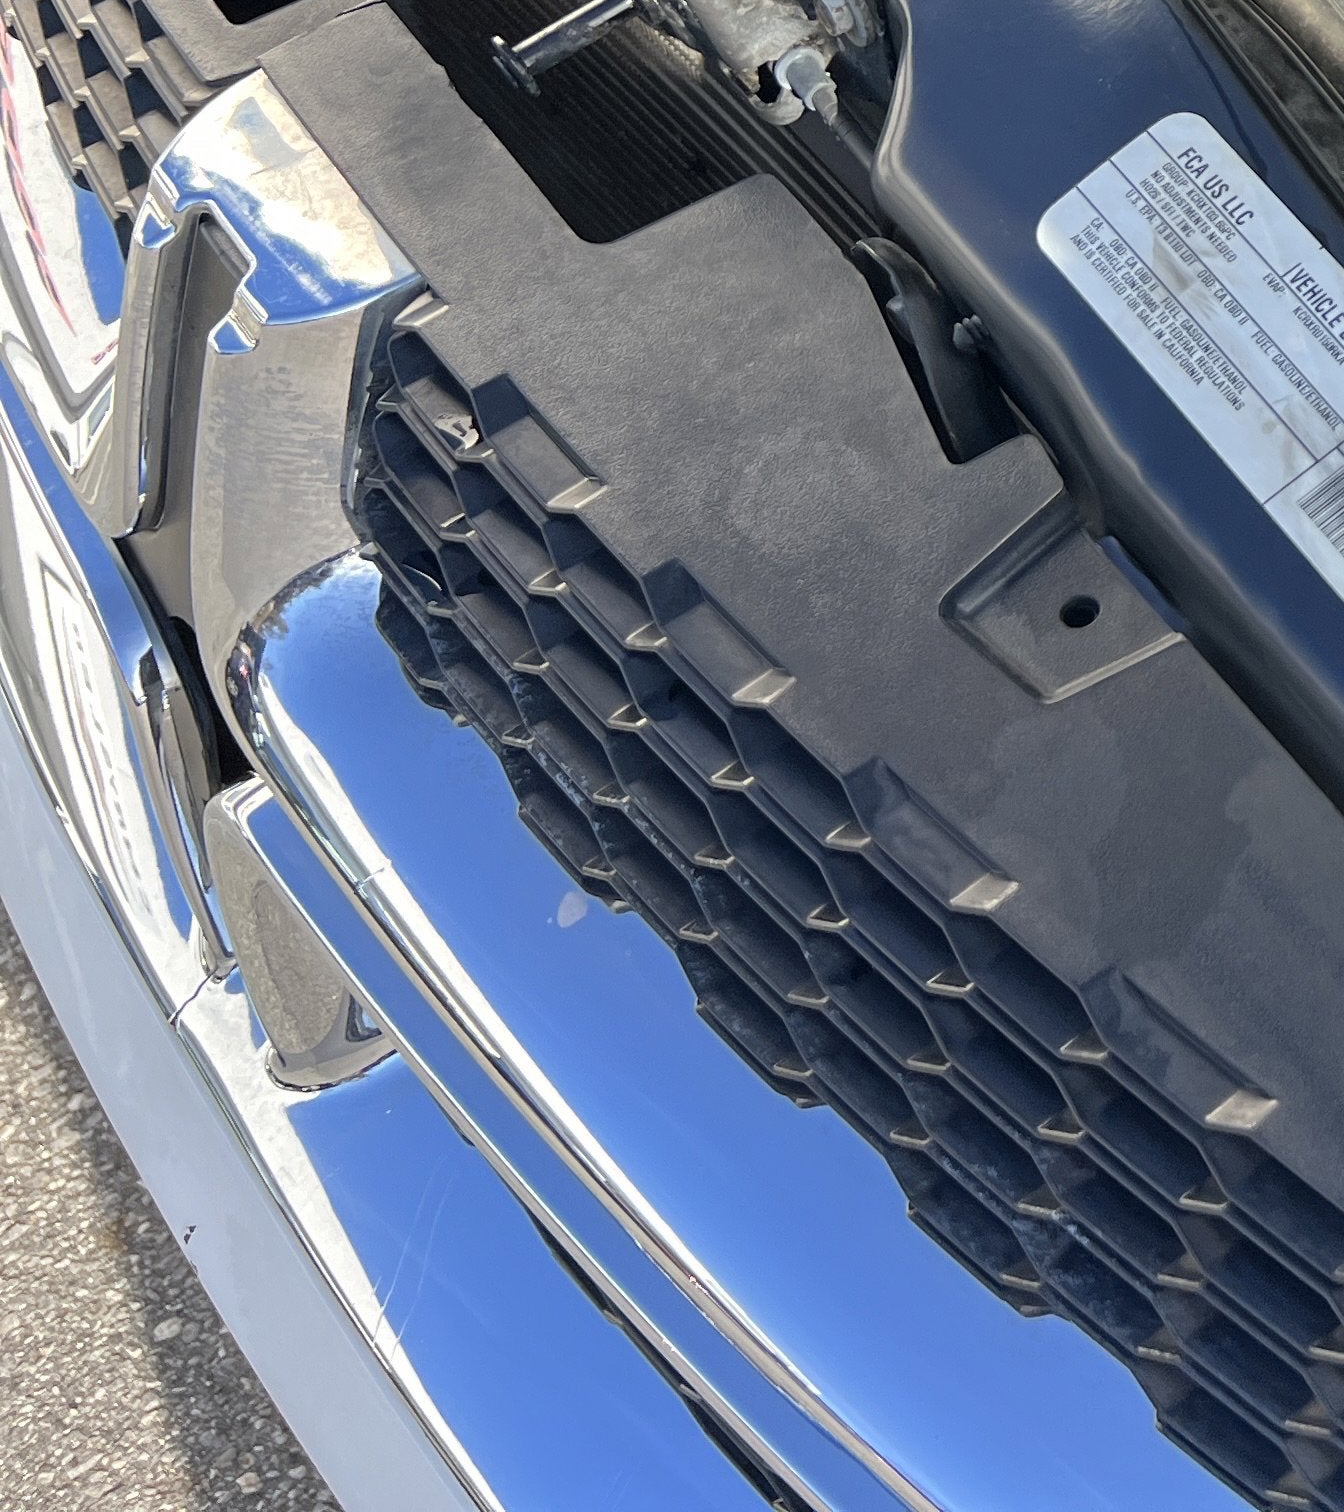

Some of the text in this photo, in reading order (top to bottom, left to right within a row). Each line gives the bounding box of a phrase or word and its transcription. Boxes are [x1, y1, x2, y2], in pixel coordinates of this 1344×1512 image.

[1149, 169, 1237, 264] NO ADJUSTMENTS NEEDED
[1161, 161, 1190, 191] GROUP:
[1261, 271, 1287, 298] EVAP:
[1175, 218, 1195, 238] TWC
[1176, 146, 1211, 179] FCA
[1202, 173, 1230, 200] US
[1222, 195, 1255, 227] LLC
[1069, 232, 1206, 386] AND IS CERTIFIED FOR SALE IN CALIFORNIA
[1079, 224, 1246, 412] THIS VEHICLE CONFORMS TO FEDERAL REGULATIONS
[1088, 216, 1105, 232] CA:
[1107, 237, 1129, 260] OBD:
[1123, 255, 1139, 270] CA
[1133, 266, 1153, 286] OBD
[1159, 295, 1184, 321] FUEL:
[1177, 317, 1249, 395] GASOLINE/ETHANOL
[1124, 188, 1143, 207] U.S.
[1138, 204, 1158, 225] EPA:
[1154, 222, 1168, 235] T3
[1179, 249, 1197, 267] LDT
[1196, 268, 1218, 291] OBD:
[1213, 287, 1228, 302] CA
[1222, 298, 1242, 319] OBD
[1250, 329, 1276, 357] FUEL:
[1269, 352, 1343, 431] GASOLINE/ETHANOL
